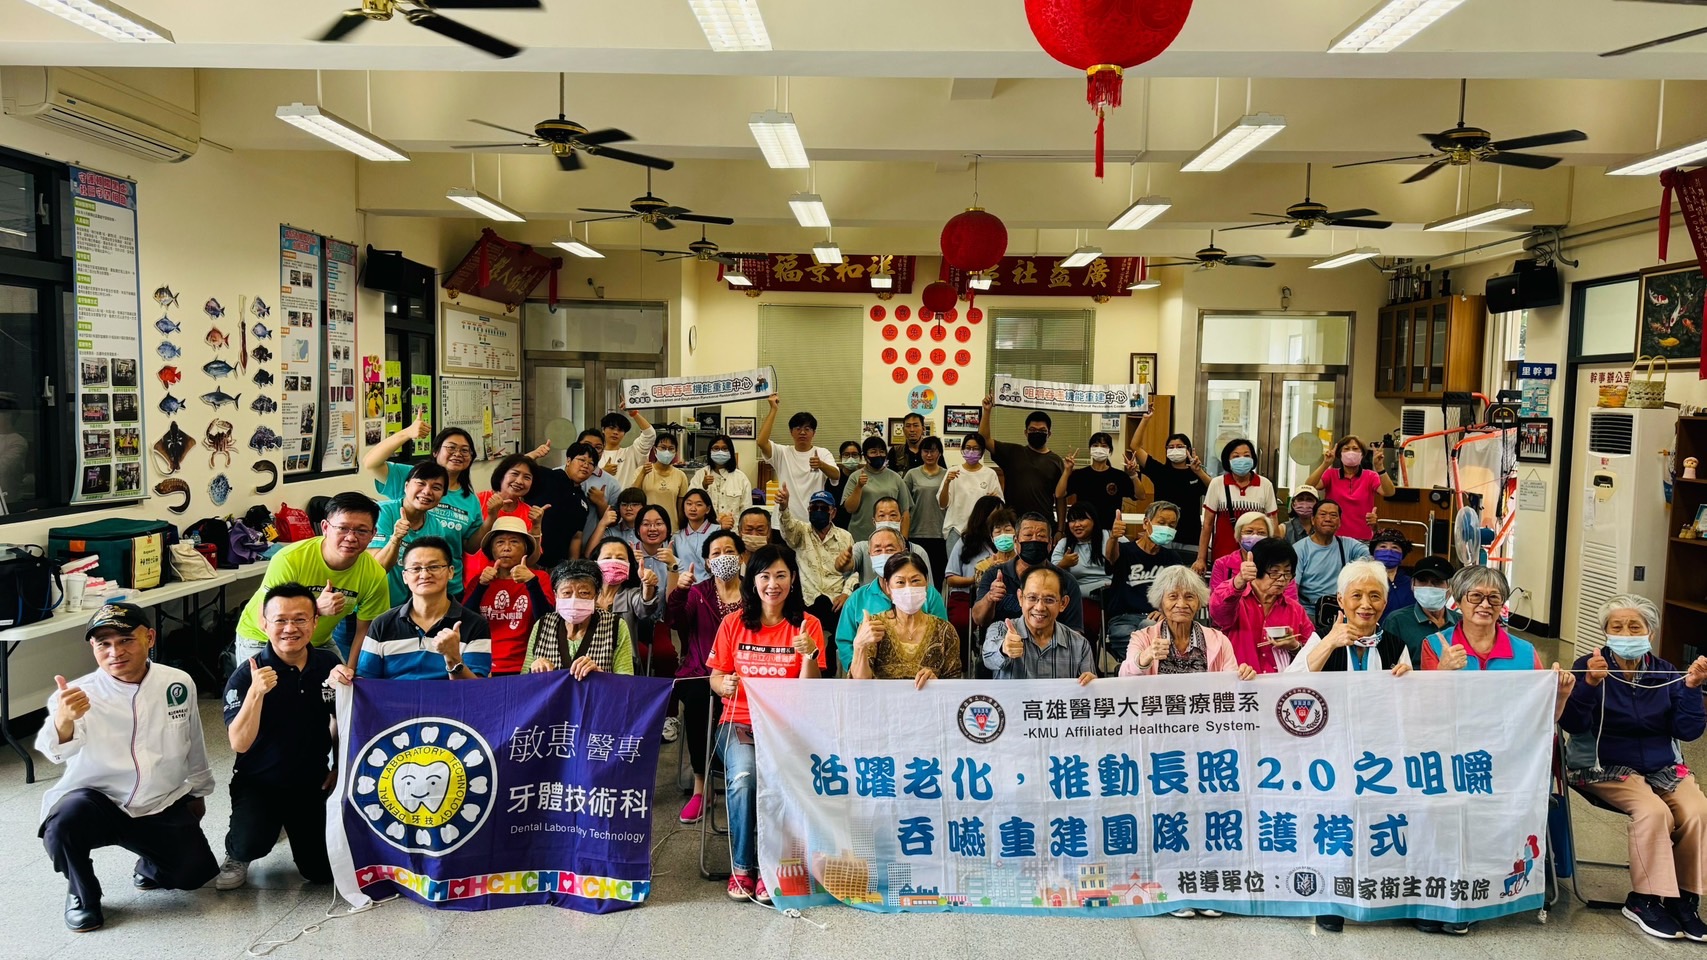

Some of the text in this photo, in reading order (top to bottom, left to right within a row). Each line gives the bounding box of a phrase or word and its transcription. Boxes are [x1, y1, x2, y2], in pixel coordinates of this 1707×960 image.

[1522, 366, 1553, 376] 里幹事
[1590, 371, 1631, 384] 幹事辦公室
[652, 377, 753, 398] 咀嚼吞嚥機能重建中心
[1023, 386, 1128, 404] 咀嚼吞嚥機能重建中心
[1129, 563, 1164, 581] Bull
[1022, 691, 1260, 722] 高雄醫學大學醫療體系
[1023, 719, 1261, 739] -KMU Affiliated Healthcare System-
[509, 721, 644, 763] 敏惠 醫專
[379, 746, 466, 823] DENTAL LABORATORY TECHNOLOGY
[507, 782, 648, 819] 牙體技術科
[411, 815, 434, 826] 牙技
[511, 822, 542, 834] Dental
[590, 829, 645, 843] Technology
[897, 812, 1409, 858] 吞嚥重建團隊照護模式
[1333, 875, 1490, 901] 國家衛生研究院
